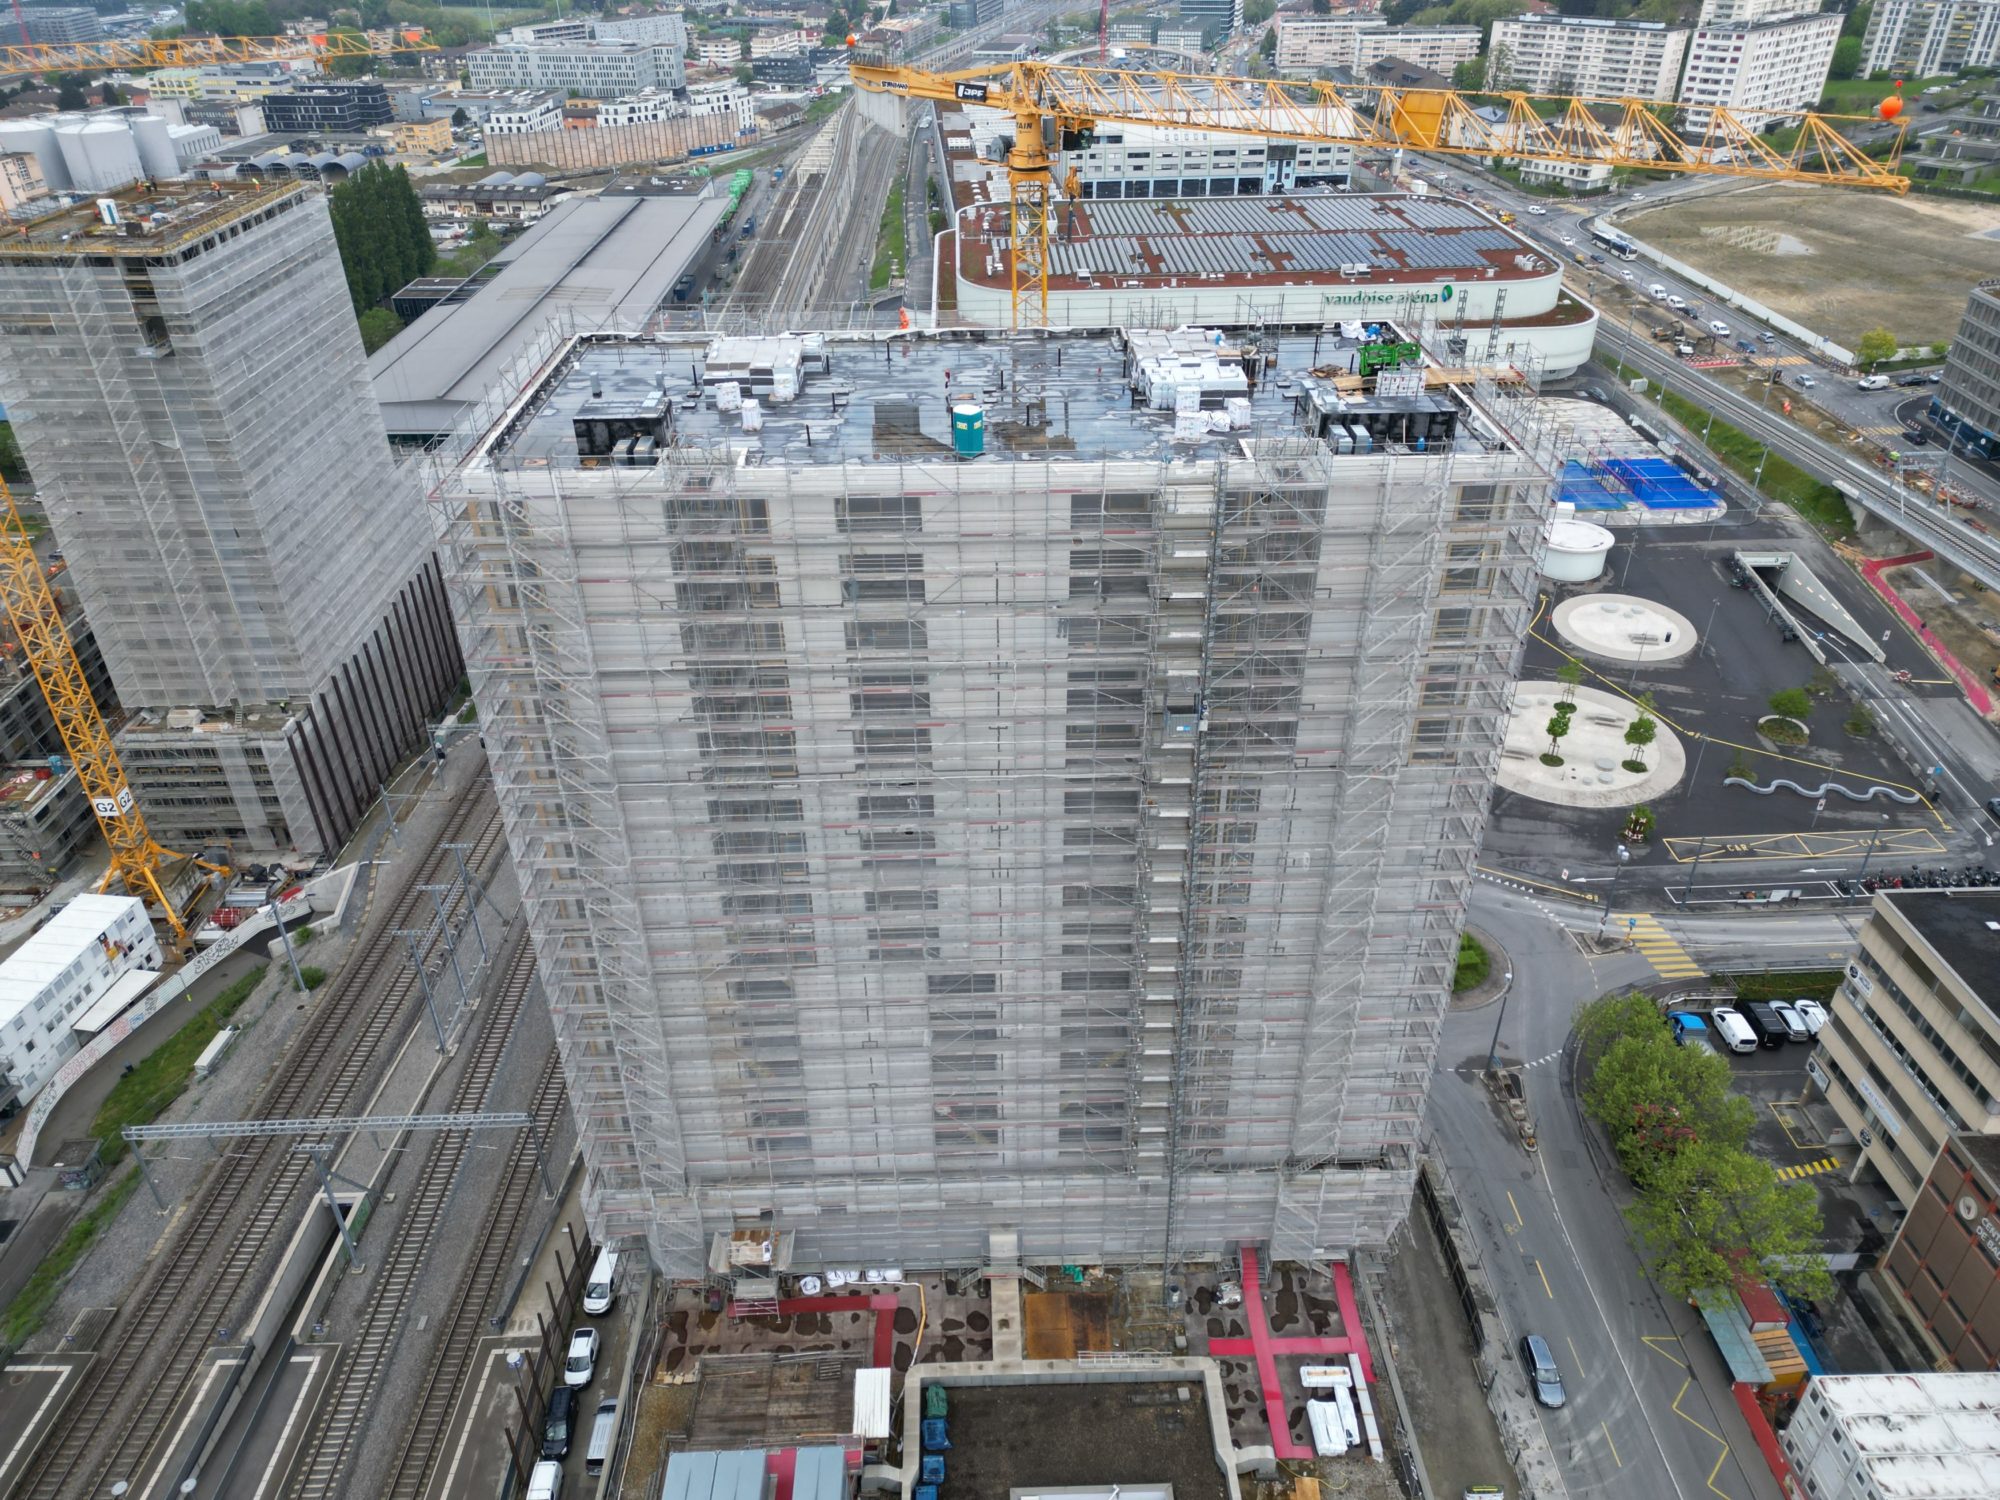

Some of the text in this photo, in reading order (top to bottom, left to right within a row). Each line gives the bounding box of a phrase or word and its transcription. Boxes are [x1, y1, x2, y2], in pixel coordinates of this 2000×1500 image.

[963, 88, 985, 97] JPF
[1325, 289, 1439, 306] vaudoise aréna
[96, 802, 117, 812] G2
[119, 791, 132, 808] G2
[1726, 844, 1749, 852] CAR
[1976, 1225, 1988, 1241] DE
[1981, 1217, 2000, 1243] CENT
